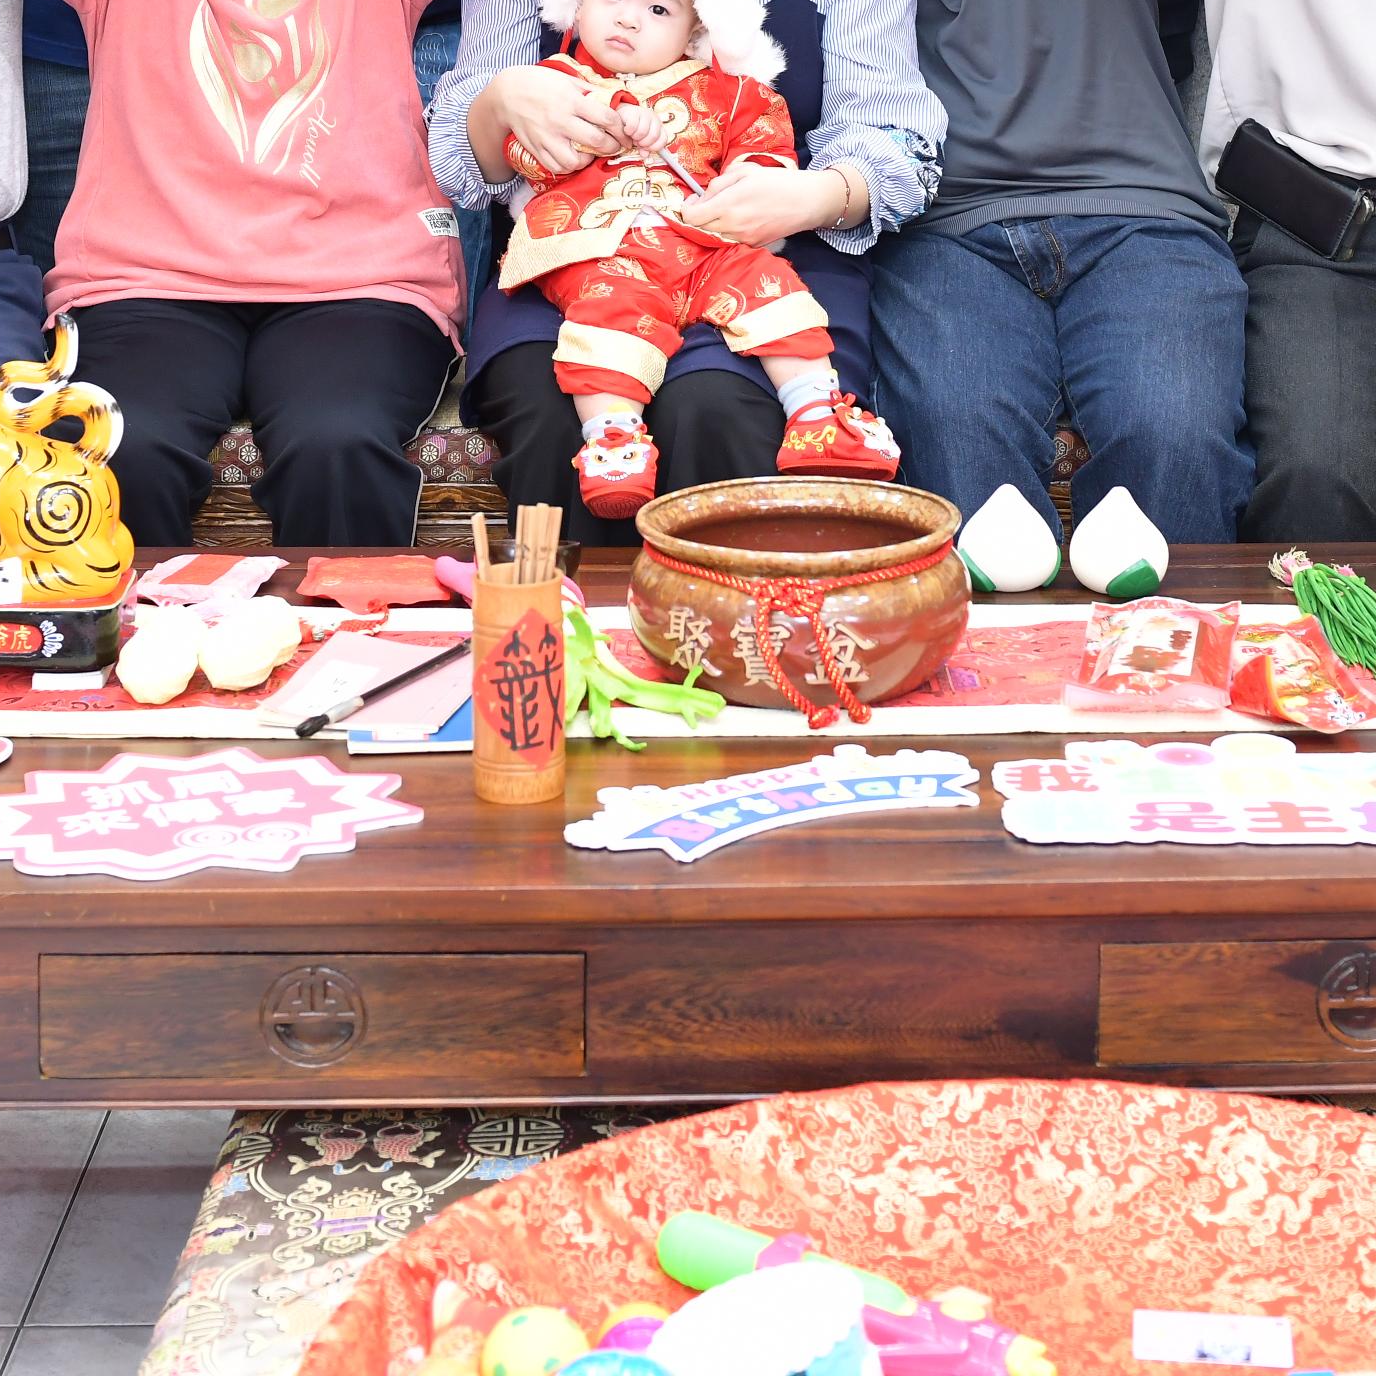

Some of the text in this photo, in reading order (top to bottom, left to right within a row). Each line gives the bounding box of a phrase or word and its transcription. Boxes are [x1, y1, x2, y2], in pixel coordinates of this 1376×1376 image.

[81, 770, 246, 812] 抓周
[679, 765, 824, 802] HAPPY
[652, 775, 938, 843] Birthday
